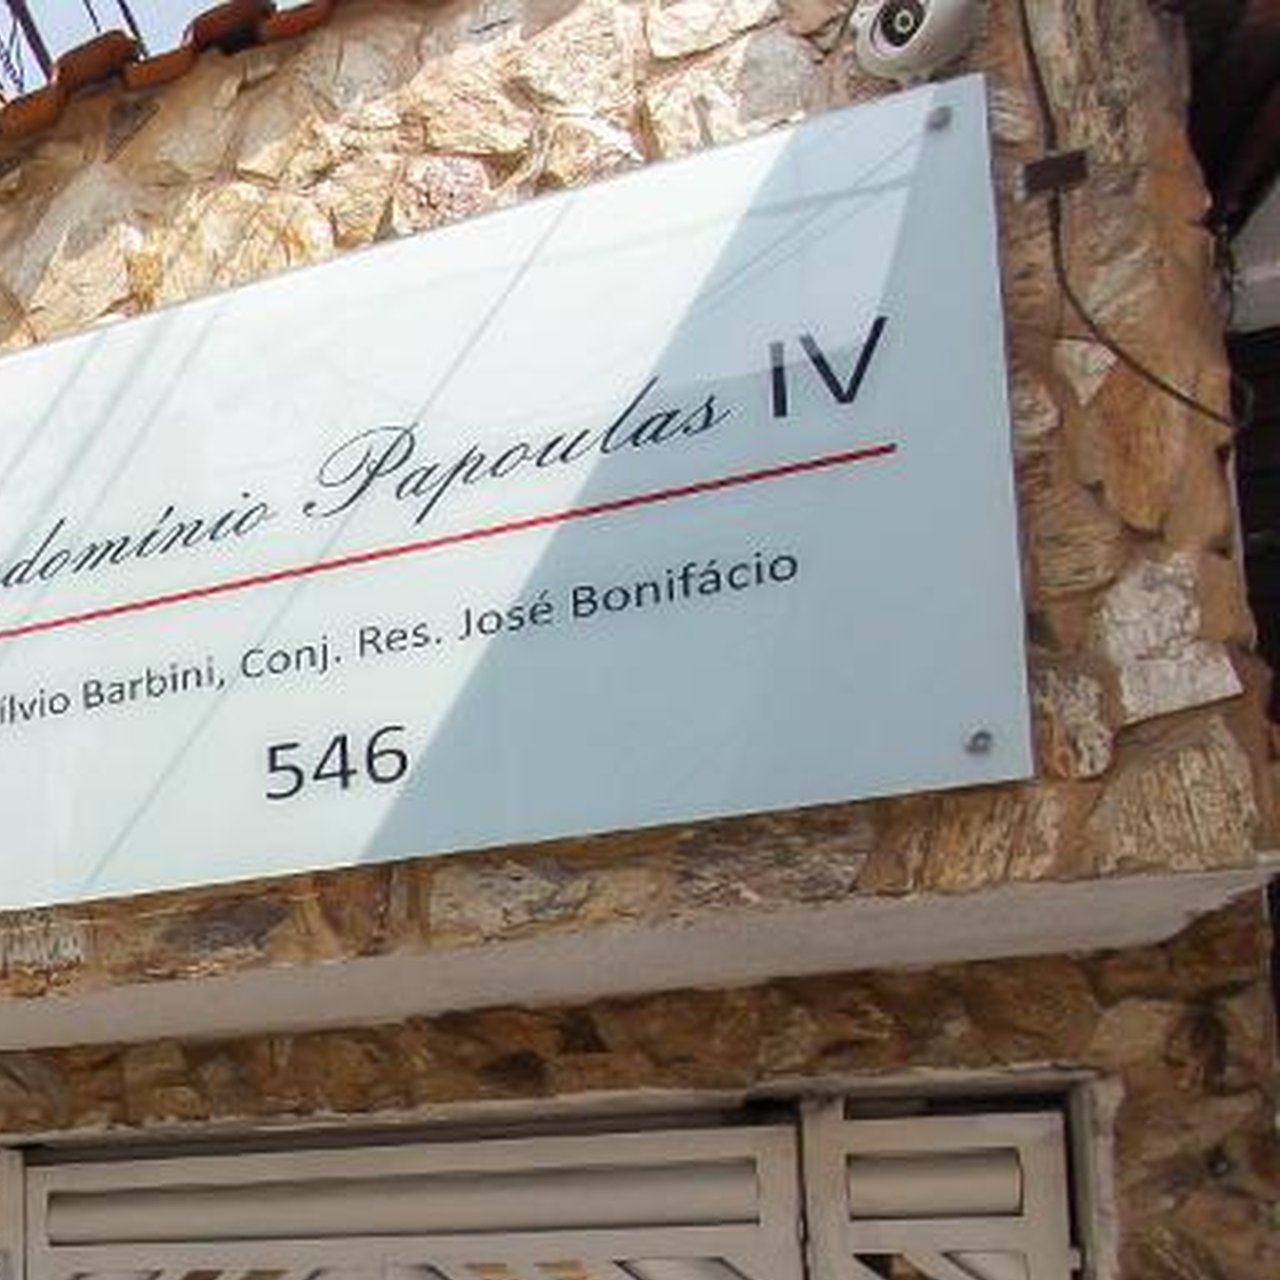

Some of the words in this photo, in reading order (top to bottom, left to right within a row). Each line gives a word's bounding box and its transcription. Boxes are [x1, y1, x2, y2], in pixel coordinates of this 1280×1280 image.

[303, 375, 736, 525] Papoulas
[768, 315, 889, 420] IV
[83, 656, 226, 709] Barbini,
[241, 635, 343, 677] Conj.
[358, 622, 443, 658] Res.
[458, 592, 555, 640] José
[572, 552, 799, 620] Bonifácio
[266, 724, 410, 801] 546
